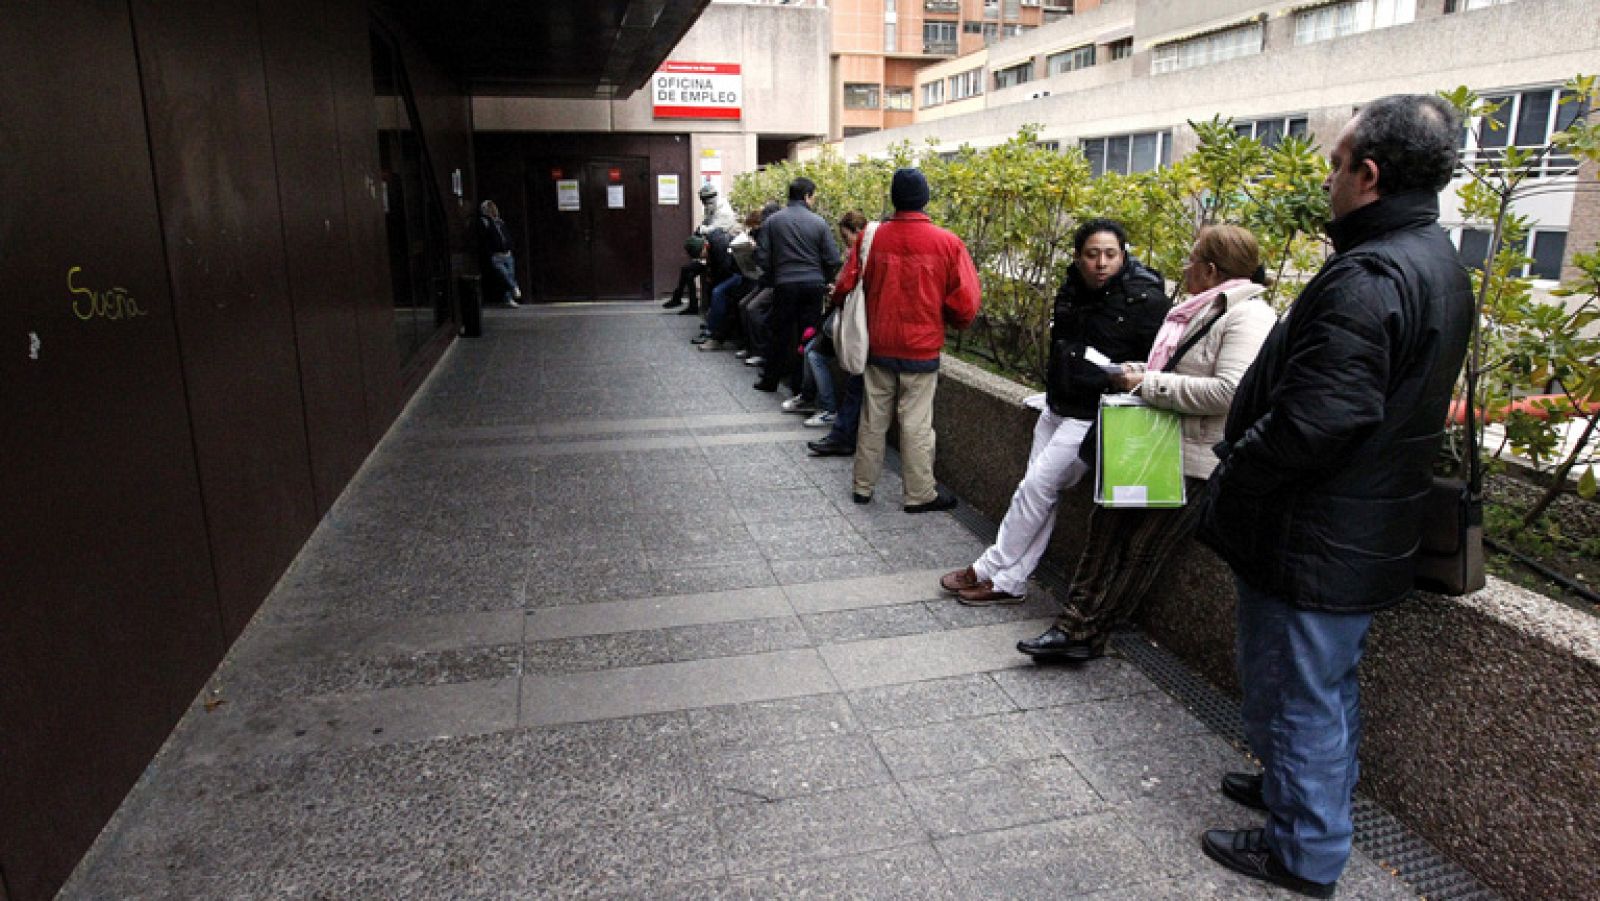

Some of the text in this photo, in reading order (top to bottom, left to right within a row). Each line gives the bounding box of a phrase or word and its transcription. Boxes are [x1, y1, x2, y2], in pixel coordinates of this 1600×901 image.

[657, 77, 713, 90] OFICINA
[657, 90, 737, 103] DE EMPLEO
[66, 266, 147, 320] Sueña
